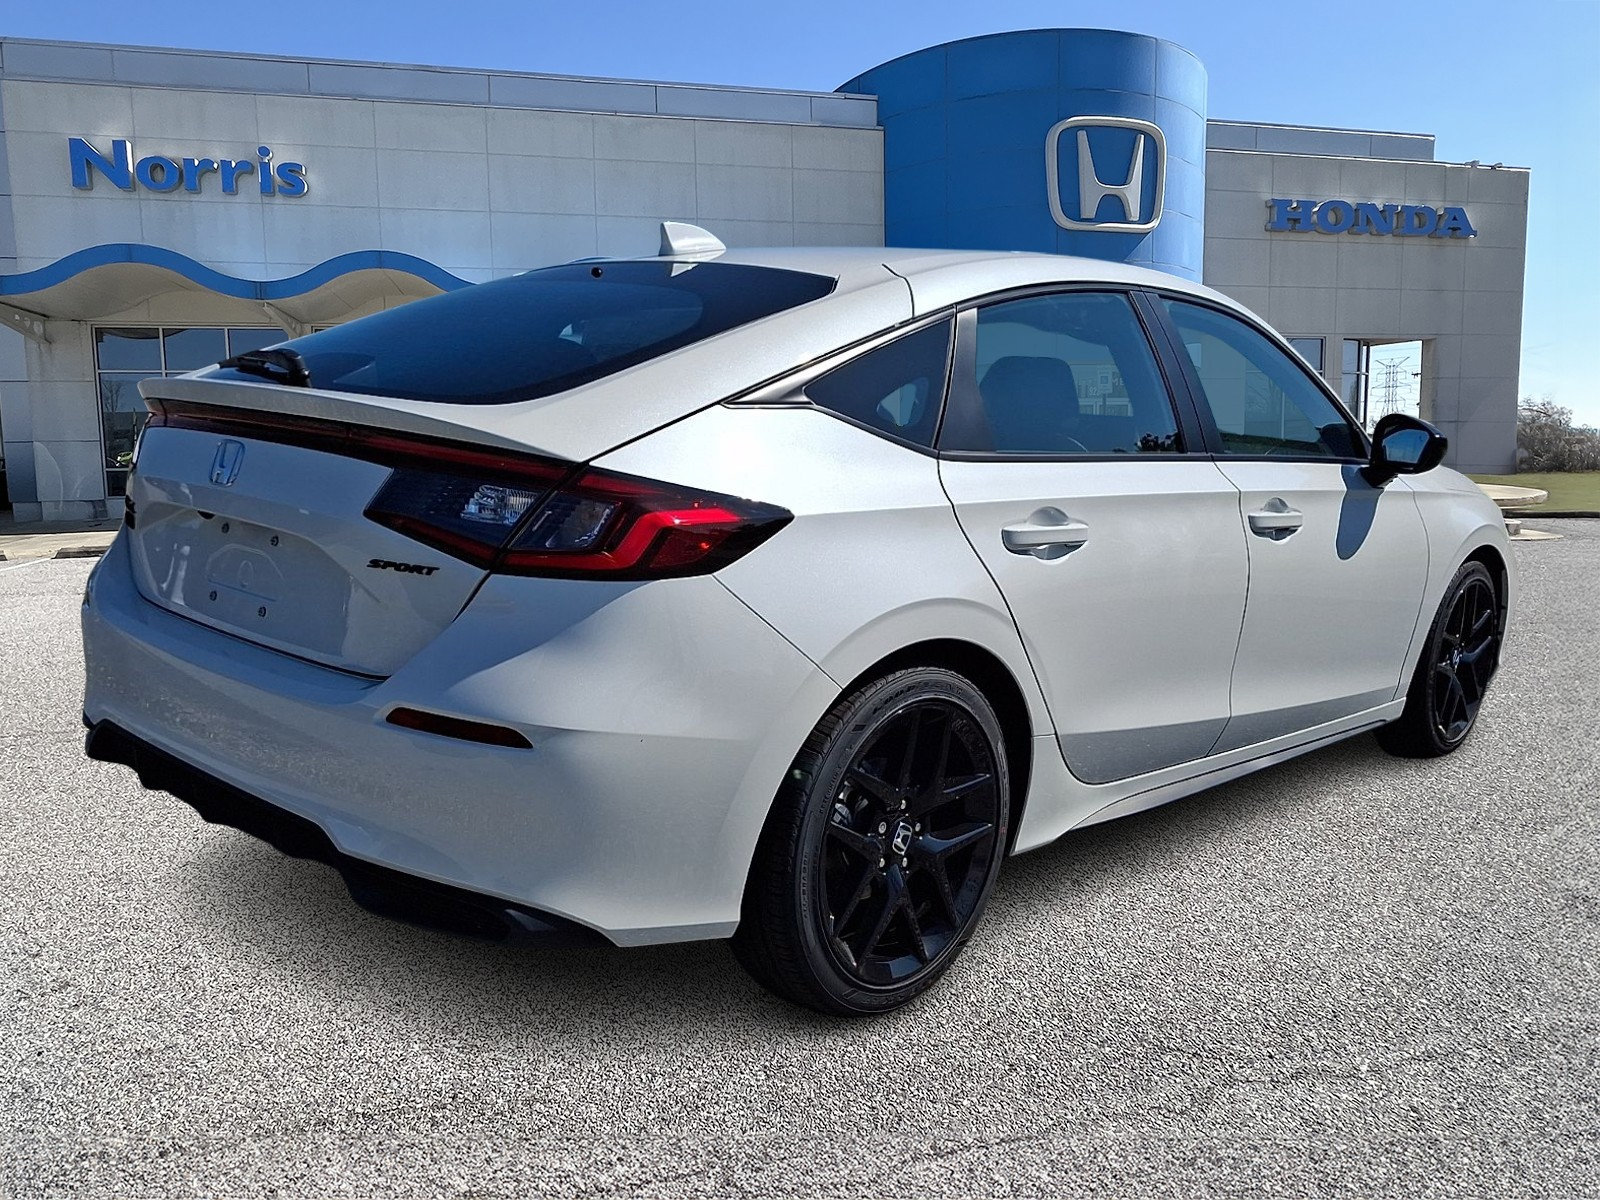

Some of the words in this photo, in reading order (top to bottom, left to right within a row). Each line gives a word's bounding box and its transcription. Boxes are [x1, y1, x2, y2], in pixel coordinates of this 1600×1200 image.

[68, 137, 308, 198] Norris
[1266, 198, 1477, 238] HONDA
[366, 559, 440, 575] SPORT
